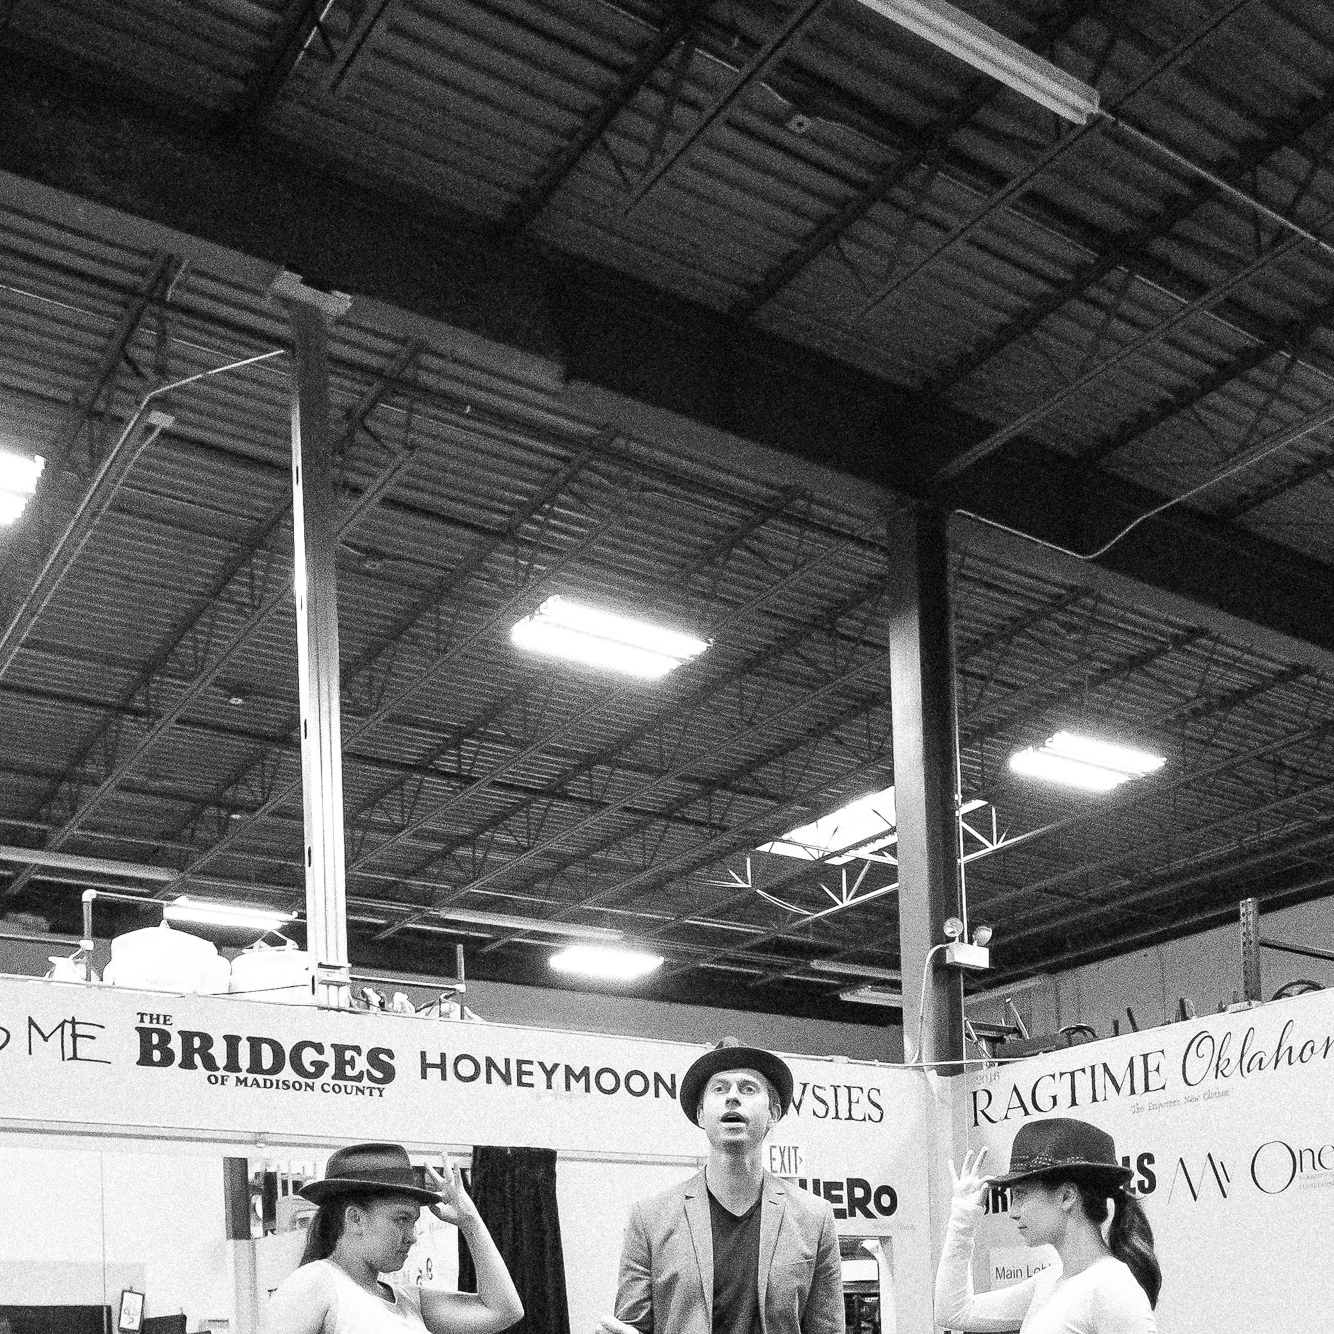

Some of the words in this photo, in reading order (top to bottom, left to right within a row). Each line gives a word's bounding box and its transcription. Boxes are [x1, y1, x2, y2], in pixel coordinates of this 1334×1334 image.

[28, 1016, 112, 1064] ME
[137, 1012, 173, 1027] THE
[134, 1026, 397, 1085] BRIDGES
[419, 1050, 677, 1101] HONEYMOON
[207, 1074, 230, 1087] OF
[235, 1076, 315, 1093] MADISON
[320, 1082, 386, 1098] COUNTY
[970, 1050, 1167, 1127] RAGTIME
[769, 1145, 799, 1174] EXIT
[1251, 1141, 1334, 1194] One
[995, 1266, 1023, 1280] Main
